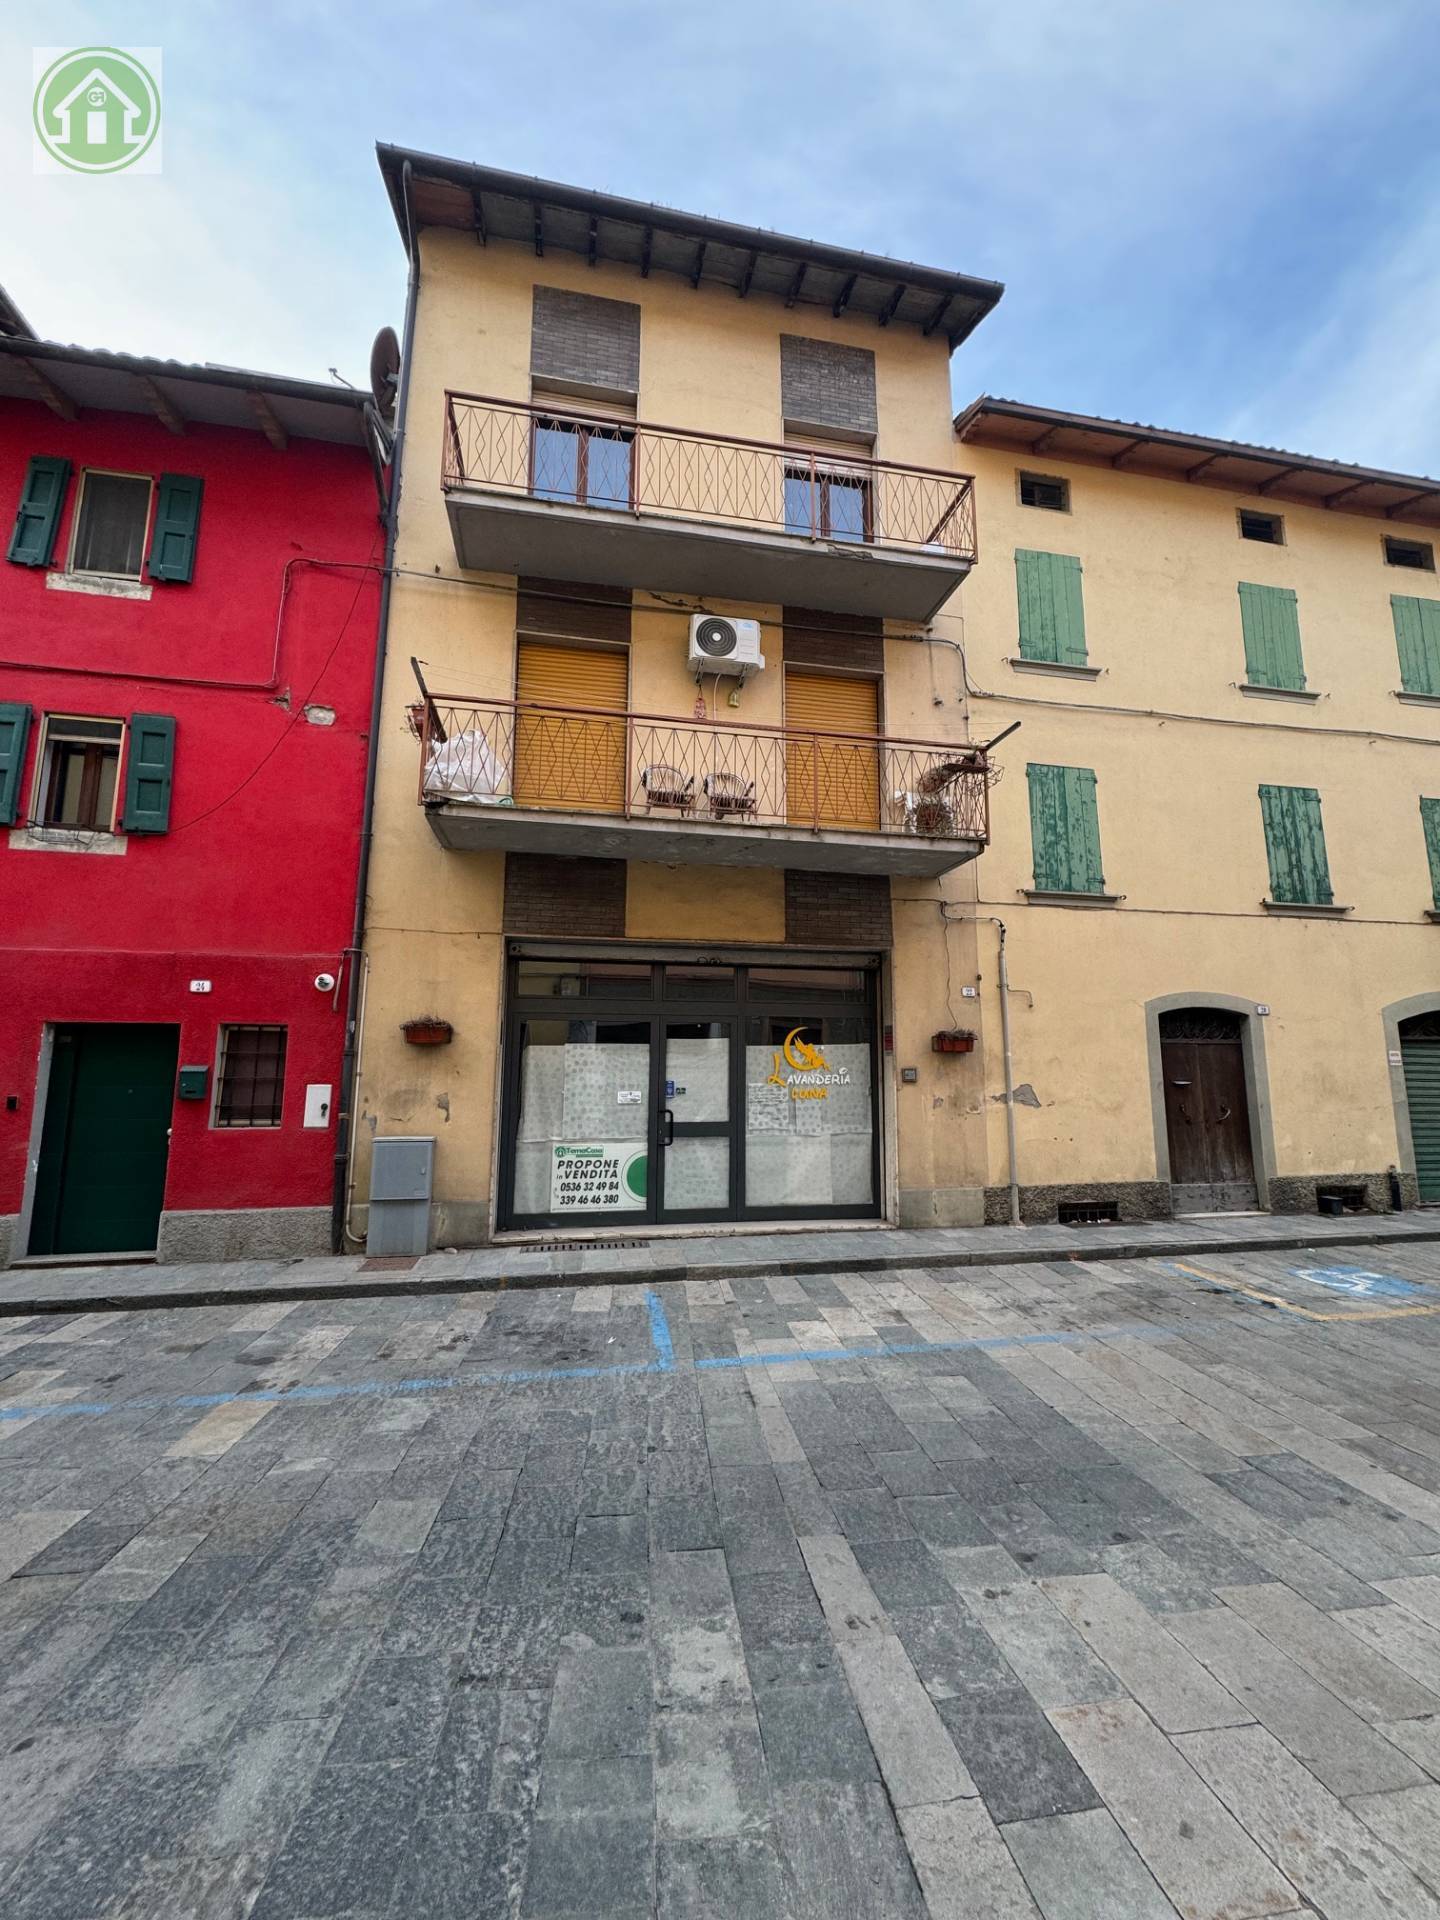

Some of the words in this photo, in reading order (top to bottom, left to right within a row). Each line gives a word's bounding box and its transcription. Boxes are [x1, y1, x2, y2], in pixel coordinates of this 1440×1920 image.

[768, 1053, 851, 1088] LAVANDERIA
[557, 1160, 619, 1169] PROPONE
[564, 1169, 618, 1179] VENDITA
[560, 1182, 582, 1192] 0536
[583, 1182, 594, 1191] 32
[595, 1181, 607, 1191] 49
[608, 1181, 619, 1191] 84
[559, 1195, 576, 1205] 339
[577, 1195, 588, 1204] 46
[590, 1195, 601, 1204] 46
[603, 1194, 619, 1204] 380
